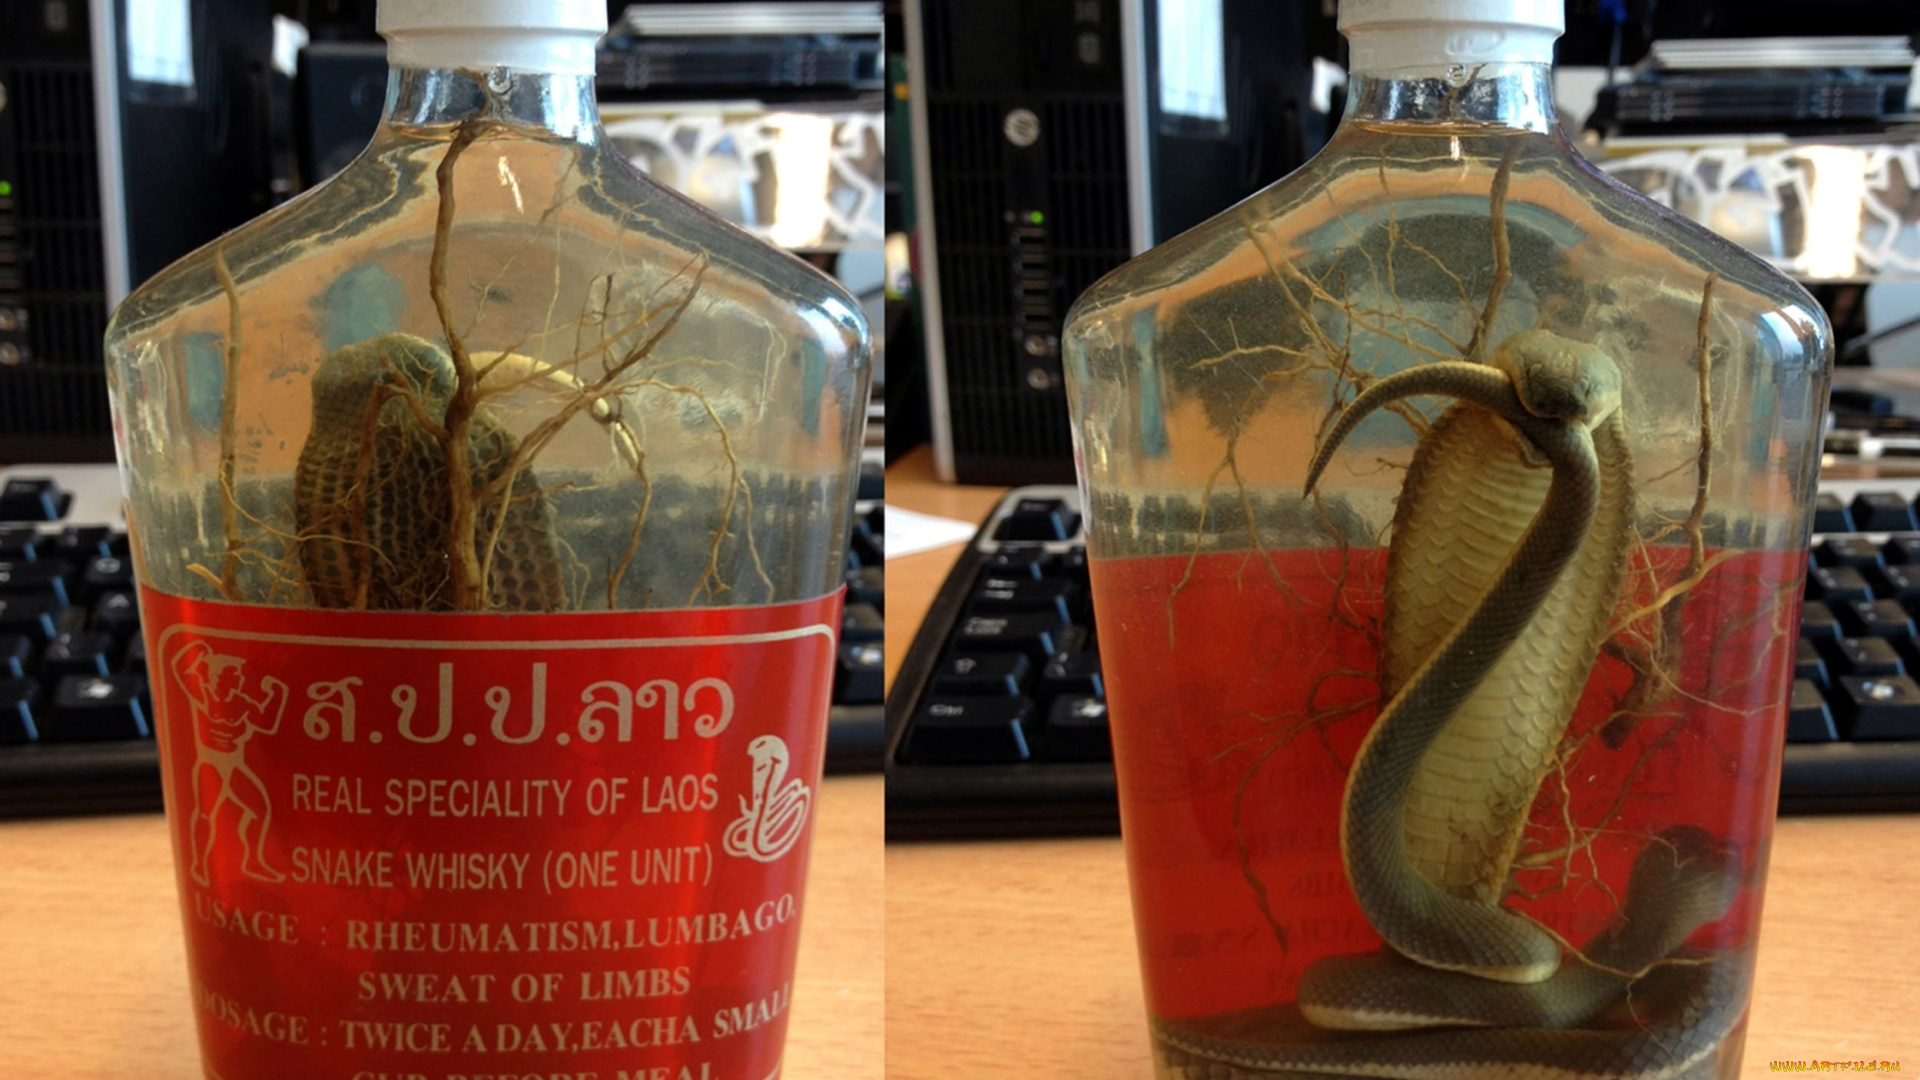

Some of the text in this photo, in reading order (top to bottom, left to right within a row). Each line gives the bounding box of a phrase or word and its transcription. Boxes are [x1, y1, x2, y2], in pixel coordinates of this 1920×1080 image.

[292, 773, 719, 817] REAL SPECIALITY OF LAOS
[291, 843, 713, 895] SNAKE WHISKY (ONE UNIT)
[195, 891, 300, 945] USAGE
[358, 966, 690, 1003] SWEAT OF LIMBS
[339, 1020, 451, 1053] TWICE
[462, 1023, 488, 1053] A
[712, 981, 791, 1040] SMALL
